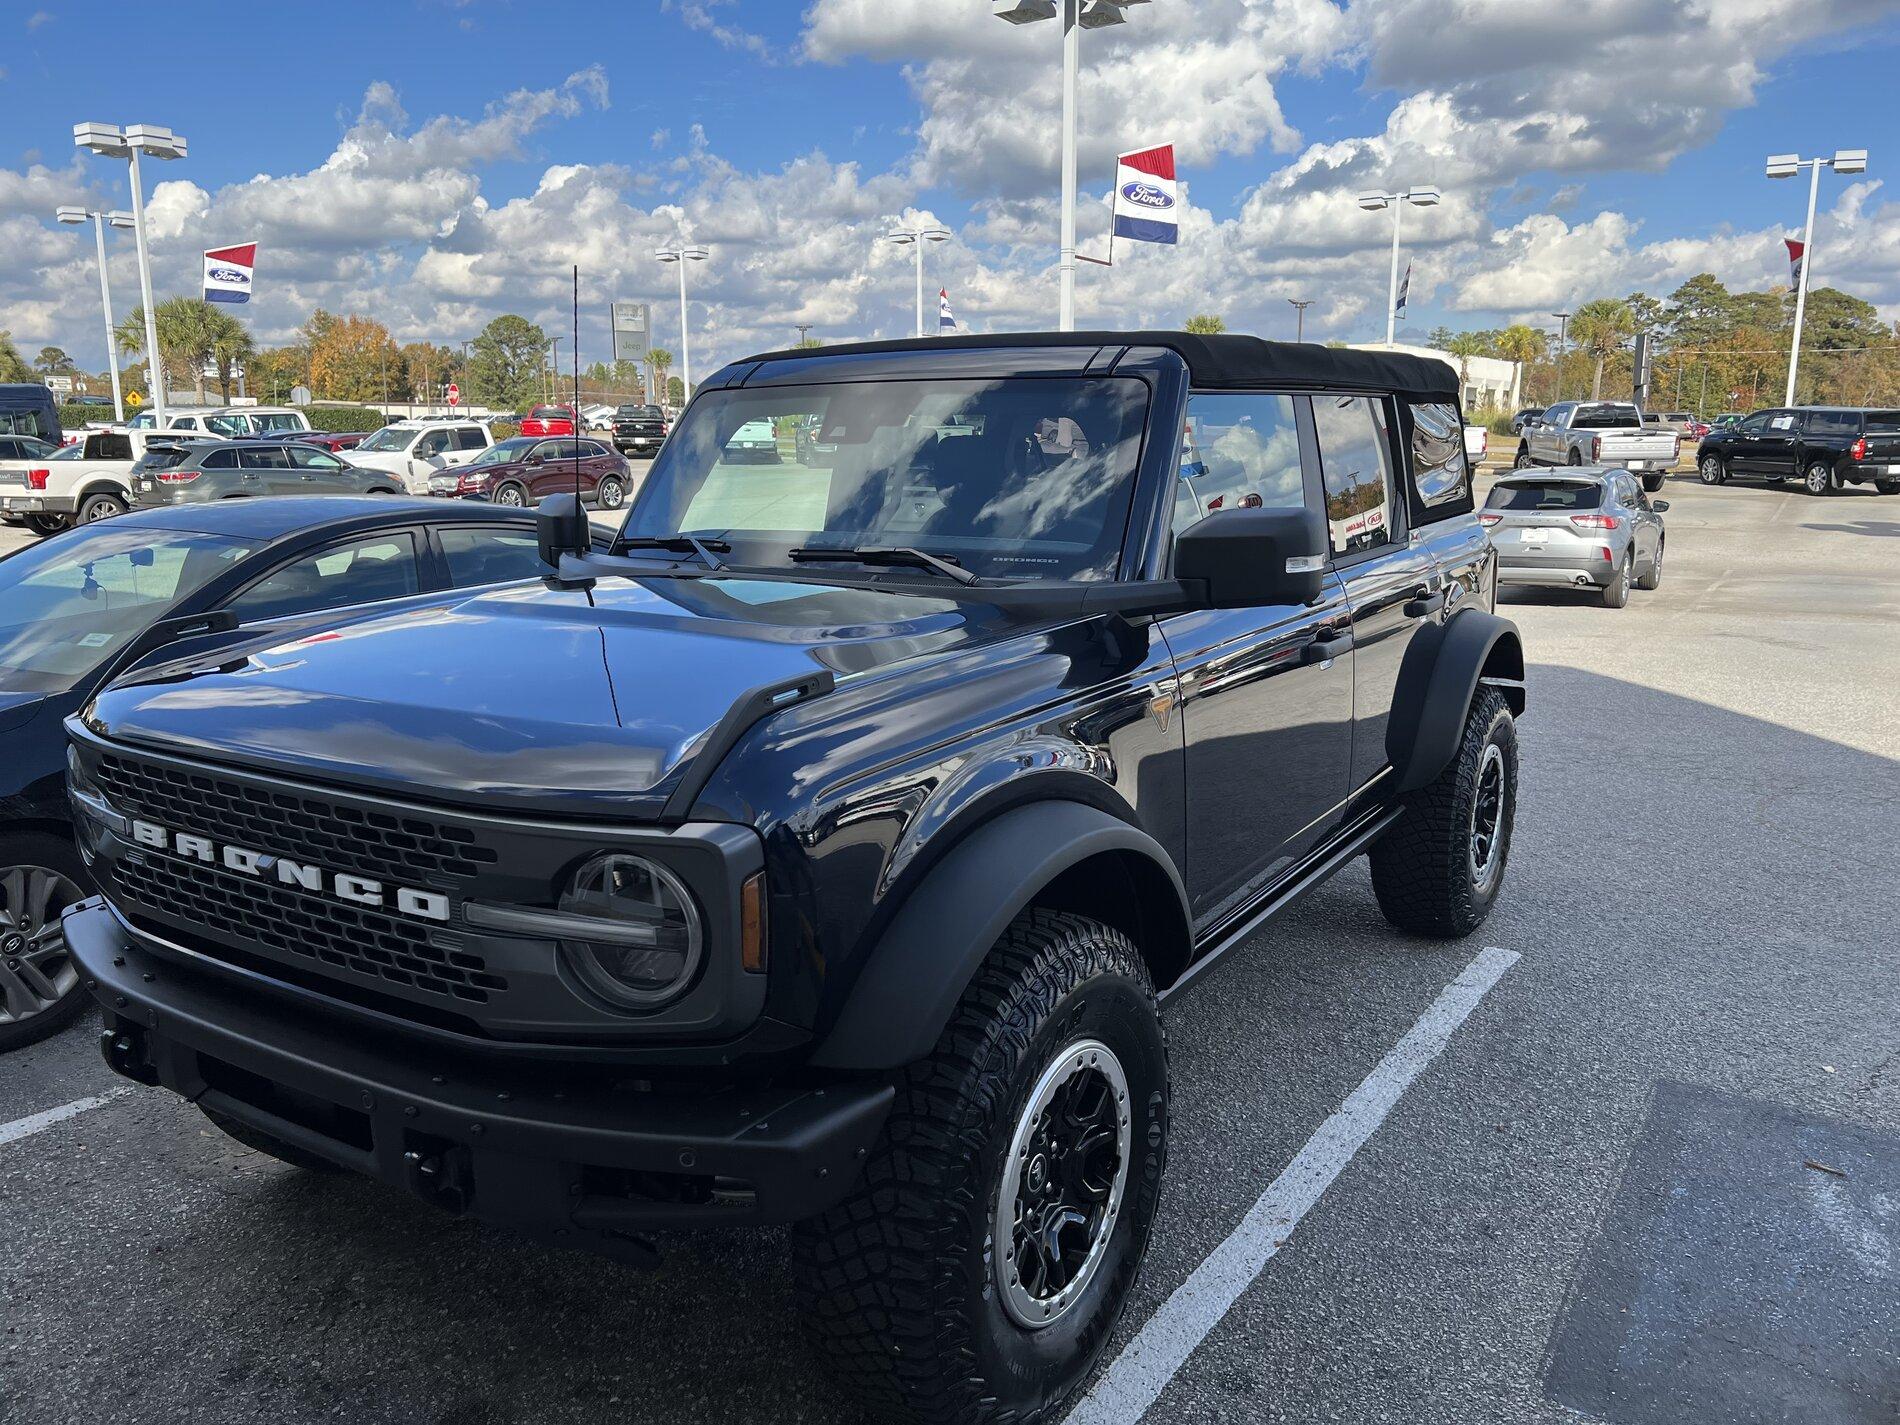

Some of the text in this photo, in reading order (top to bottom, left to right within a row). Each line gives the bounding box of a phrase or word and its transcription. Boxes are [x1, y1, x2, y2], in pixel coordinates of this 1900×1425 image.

[1130, 184, 1165, 206] Ford
[214, 269, 243, 281] Ford
[622, 340, 641, 351] Jeep
[132, 819, 450, 921] BRONCO
